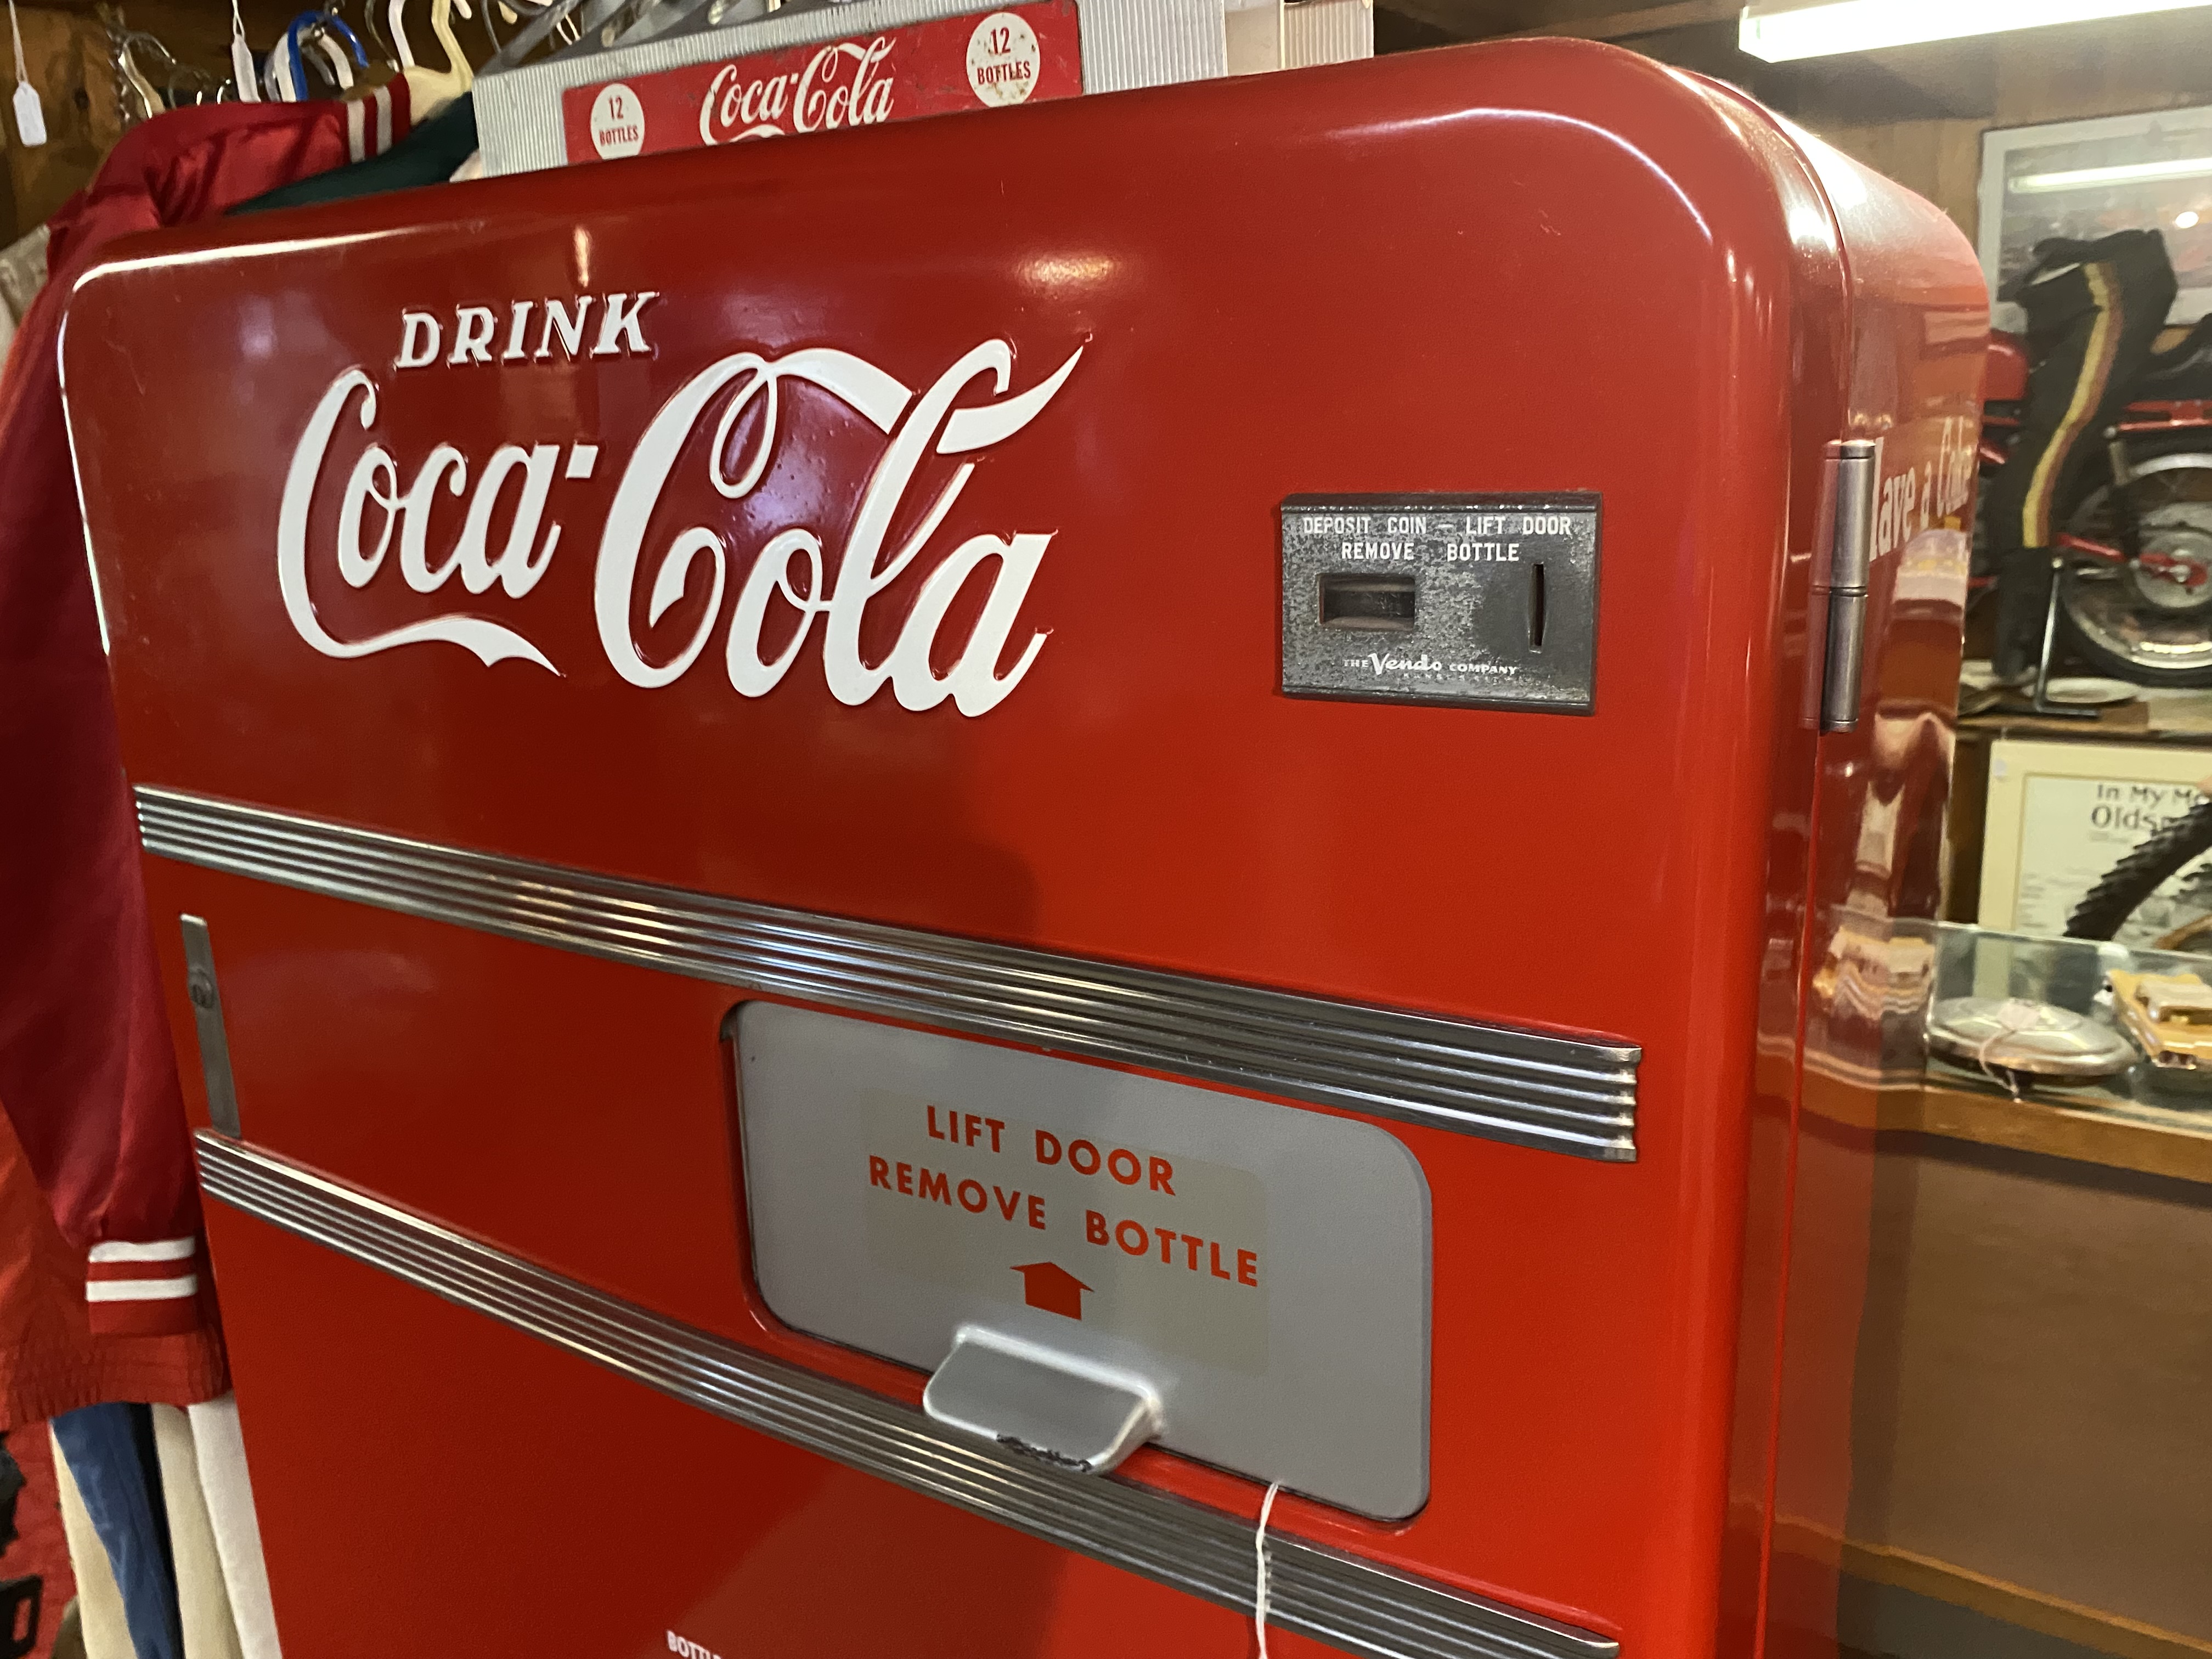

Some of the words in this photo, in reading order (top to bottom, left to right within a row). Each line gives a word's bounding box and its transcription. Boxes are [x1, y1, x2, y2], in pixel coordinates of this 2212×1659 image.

[991, 27, 1011, 55] 12
[977, 61, 1031, 86] BOTTLES
[699, 36, 896, 146] Coca-Cola
[609, 95, 623, 120] 12
[599, 125, 639, 146] BOTTLES
[394, 291, 659, 370] DRINK
[278, 338, 1086, 718] Coca-Cola
[1303, 517, 1371, 534] DEPOSIT
[1387, 517, 1426, 534] COIN
[1465, 516, 1505, 534] LIFT
[1522, 516, 1571, 535] DOOR
[1341, 542, 1414, 560] REMOVE
[1447, 543, 1520, 562] BOTTLE
[1344, 659, 1369, 668] THE
[1368, 653, 1442, 675] Vendo
[1449, 663, 1517, 675] COMPANY
[2097, 785, 2119, 799] In
[927, 1105, 1005, 1153] LIFT
[1035, 1129, 1176, 1196] DOOR
[869, 1155, 1046, 1230] REMOVE
[1086, 1210, 1259, 1287] BOTTLE
